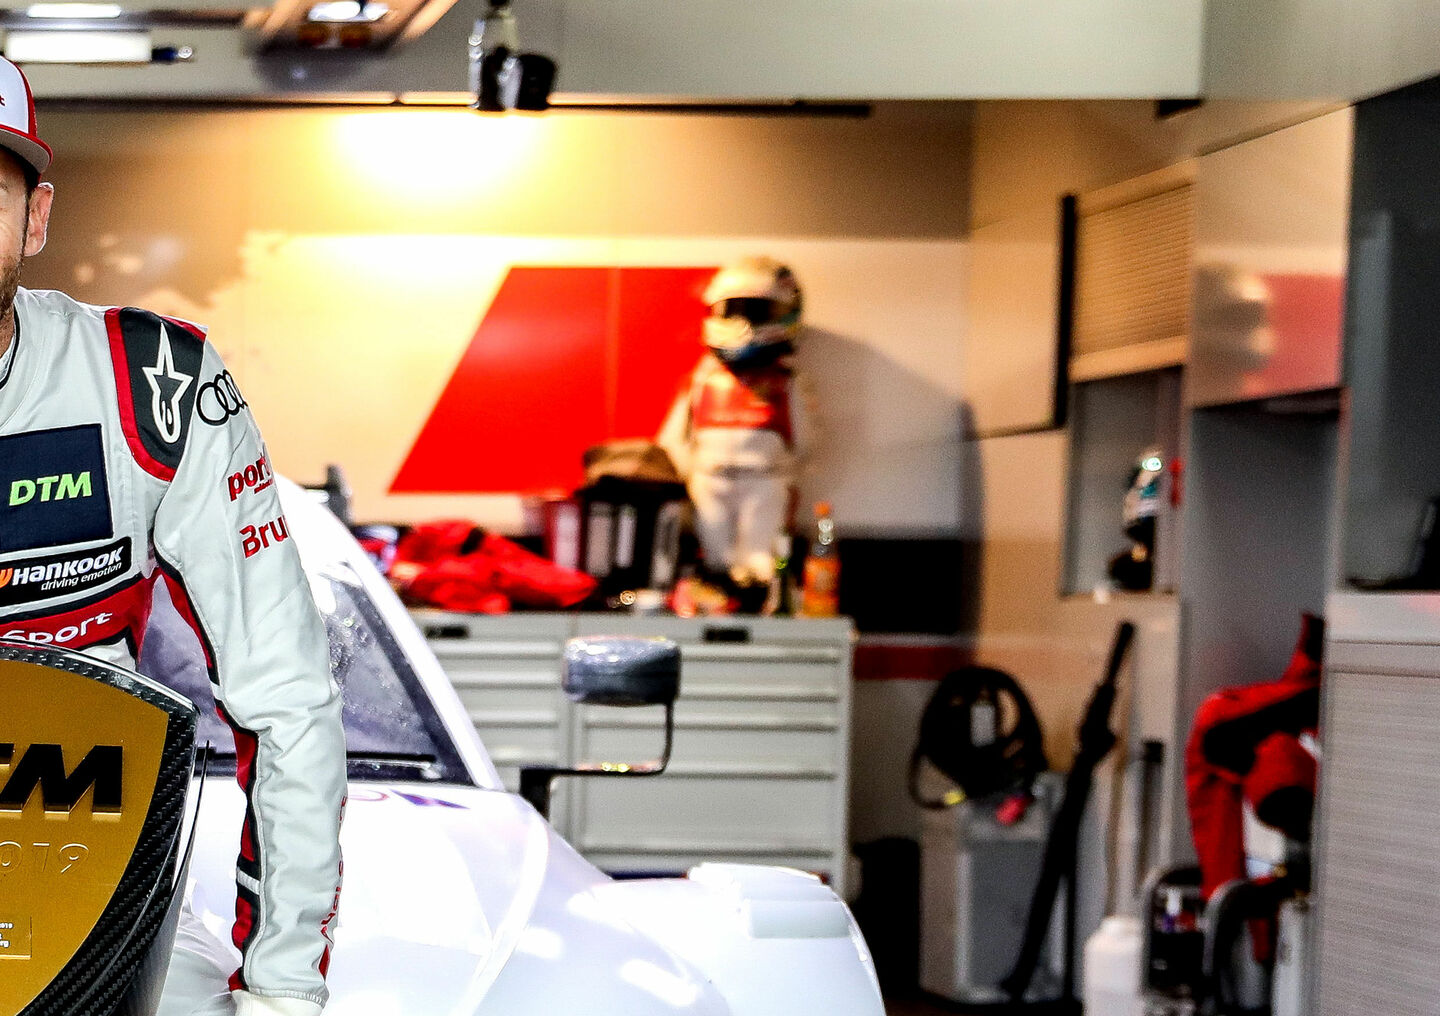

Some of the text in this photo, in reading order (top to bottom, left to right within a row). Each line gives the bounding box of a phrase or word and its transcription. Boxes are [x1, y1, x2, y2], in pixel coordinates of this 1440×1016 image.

[9, 471, 93, 507] DTM
[239, 514, 290, 559] Bru
[41, 562, 122, 591] driving emotion
